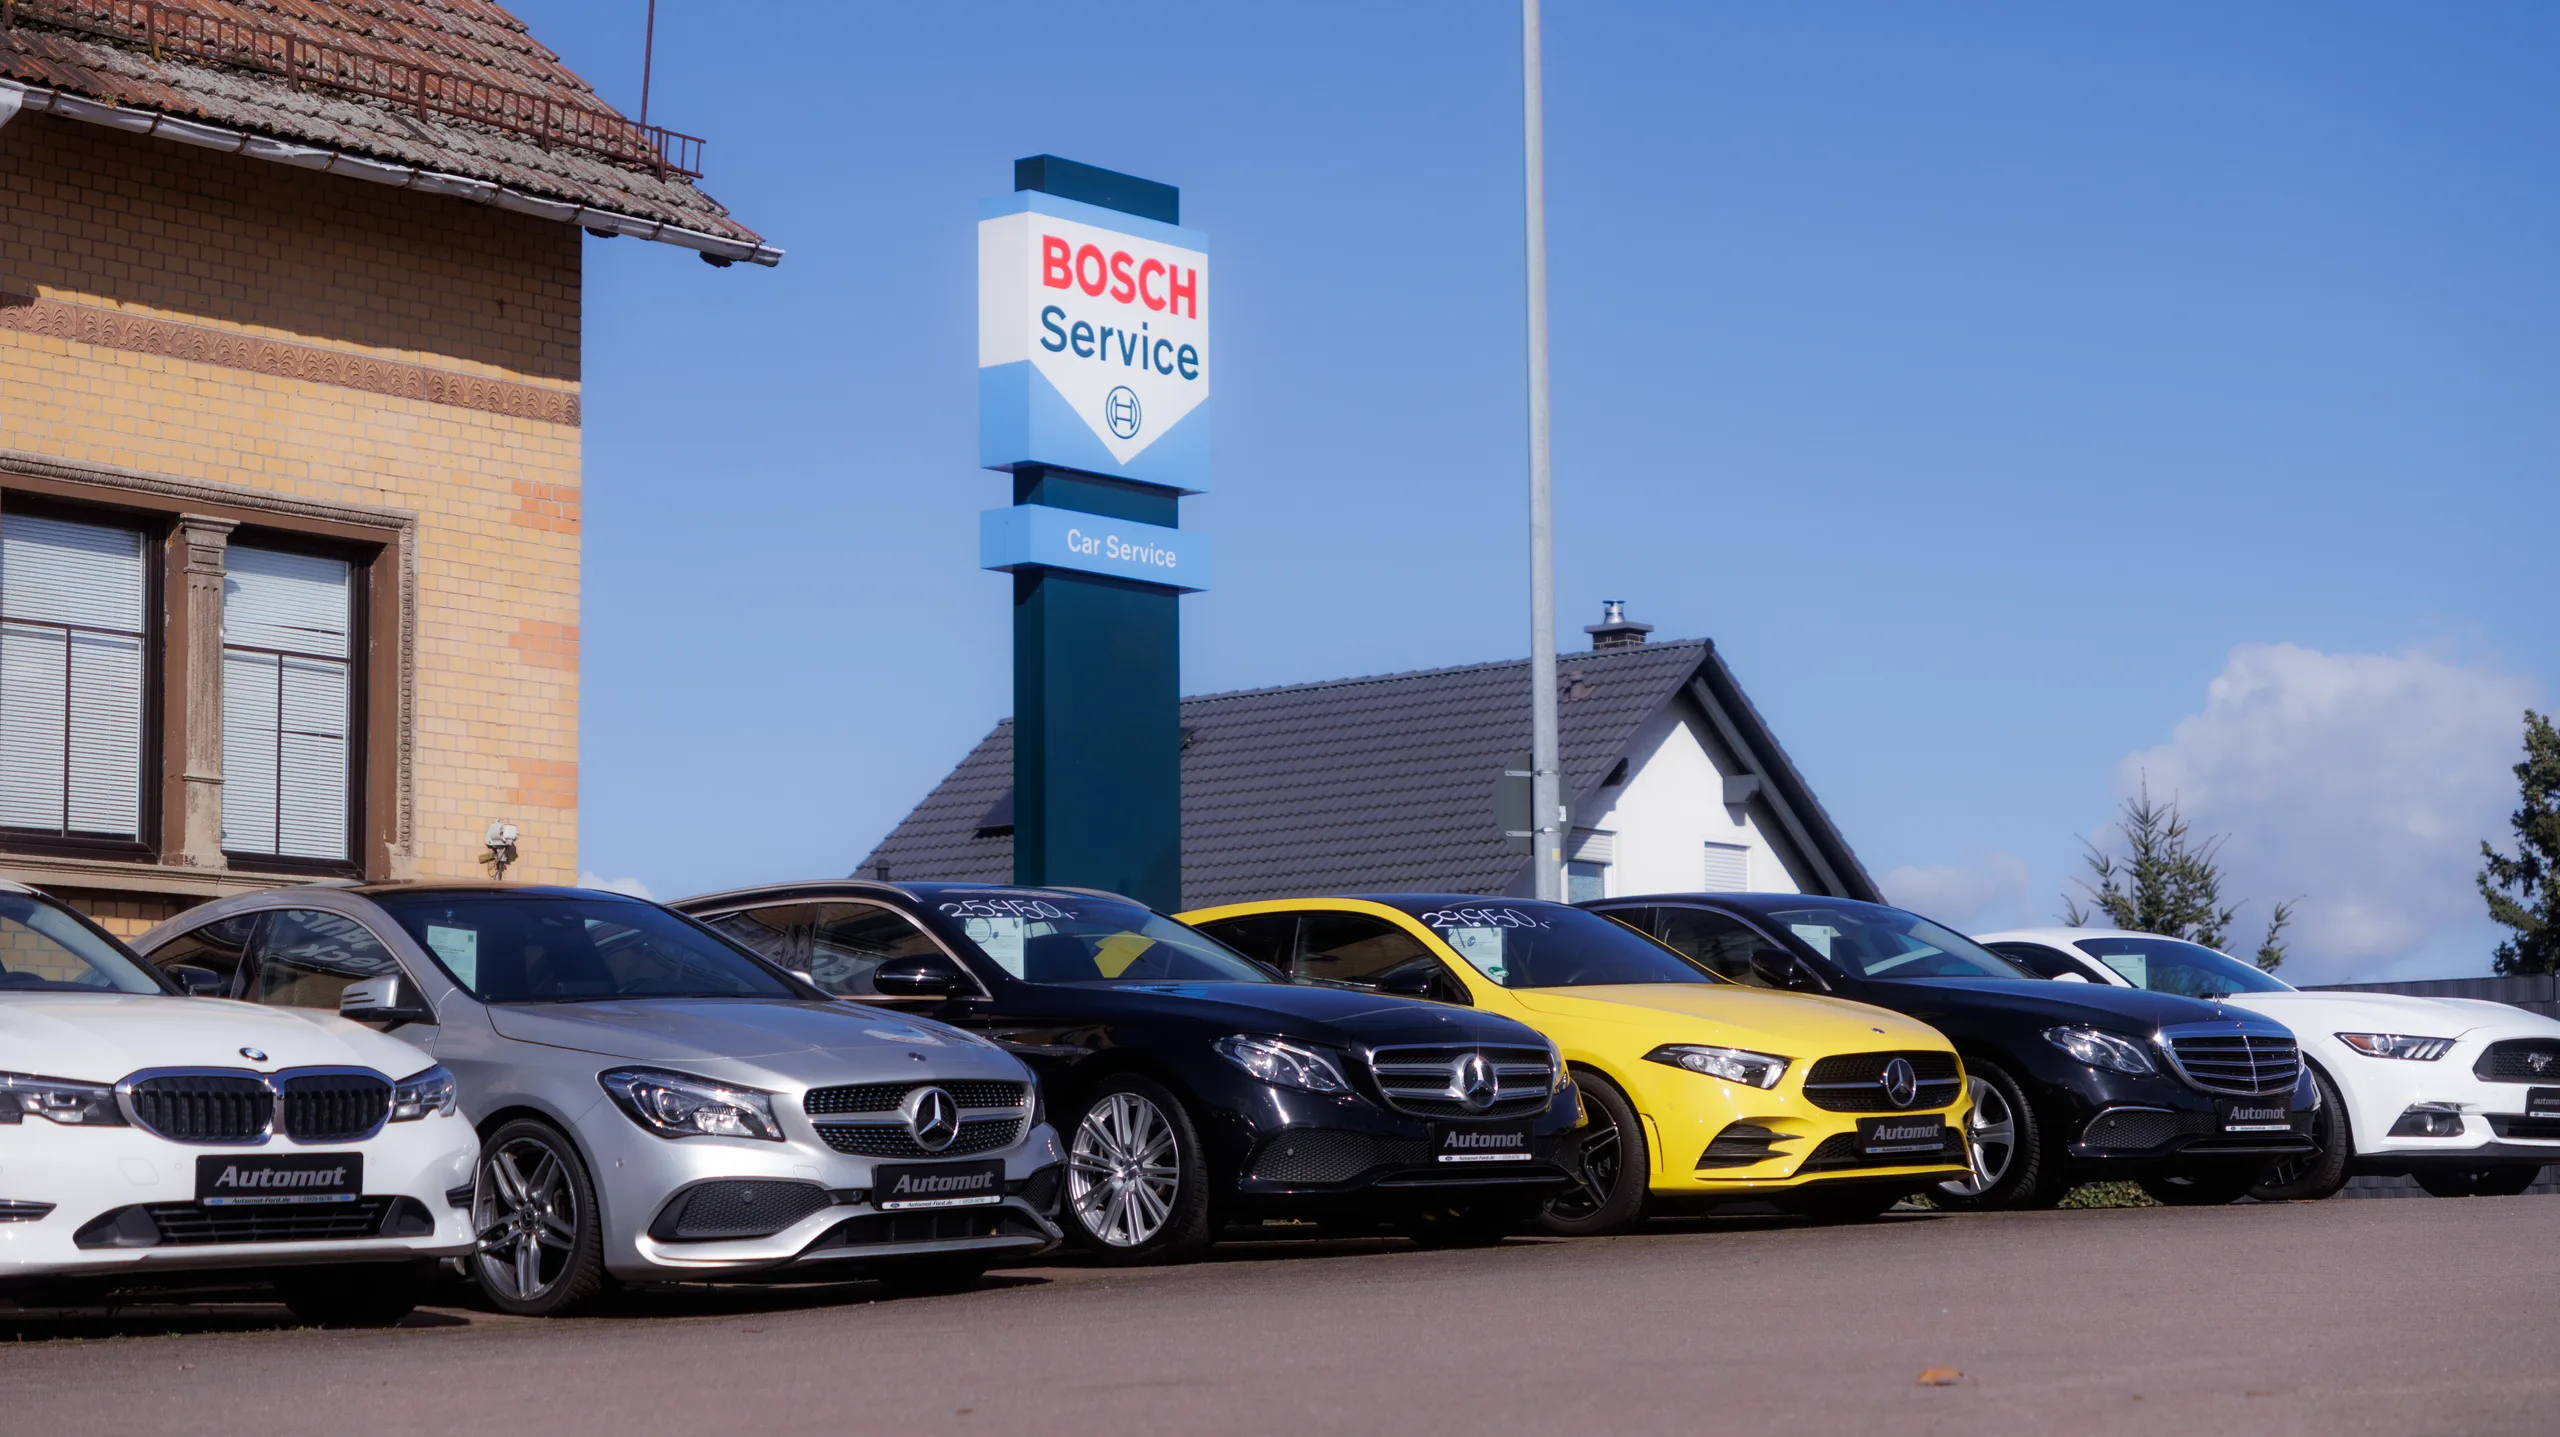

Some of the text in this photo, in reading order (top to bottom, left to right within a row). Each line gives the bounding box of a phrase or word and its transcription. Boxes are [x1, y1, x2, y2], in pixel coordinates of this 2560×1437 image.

[1043, 234, 1196, 320] BOSCH
[1040, 305, 1199, 380] Service
[1067, 528, 1177, 568] Car Service
[2229, 1105, 2286, 1120] Automot
[2533, 1097, 2560, 1105] automo
[1443, 1130, 1525, 1148] Automot
[1872, 1123, 1940, 1141] Automot
[214, 1164, 347, 1188] Automot
[891, 1170, 995, 1194] Automot
